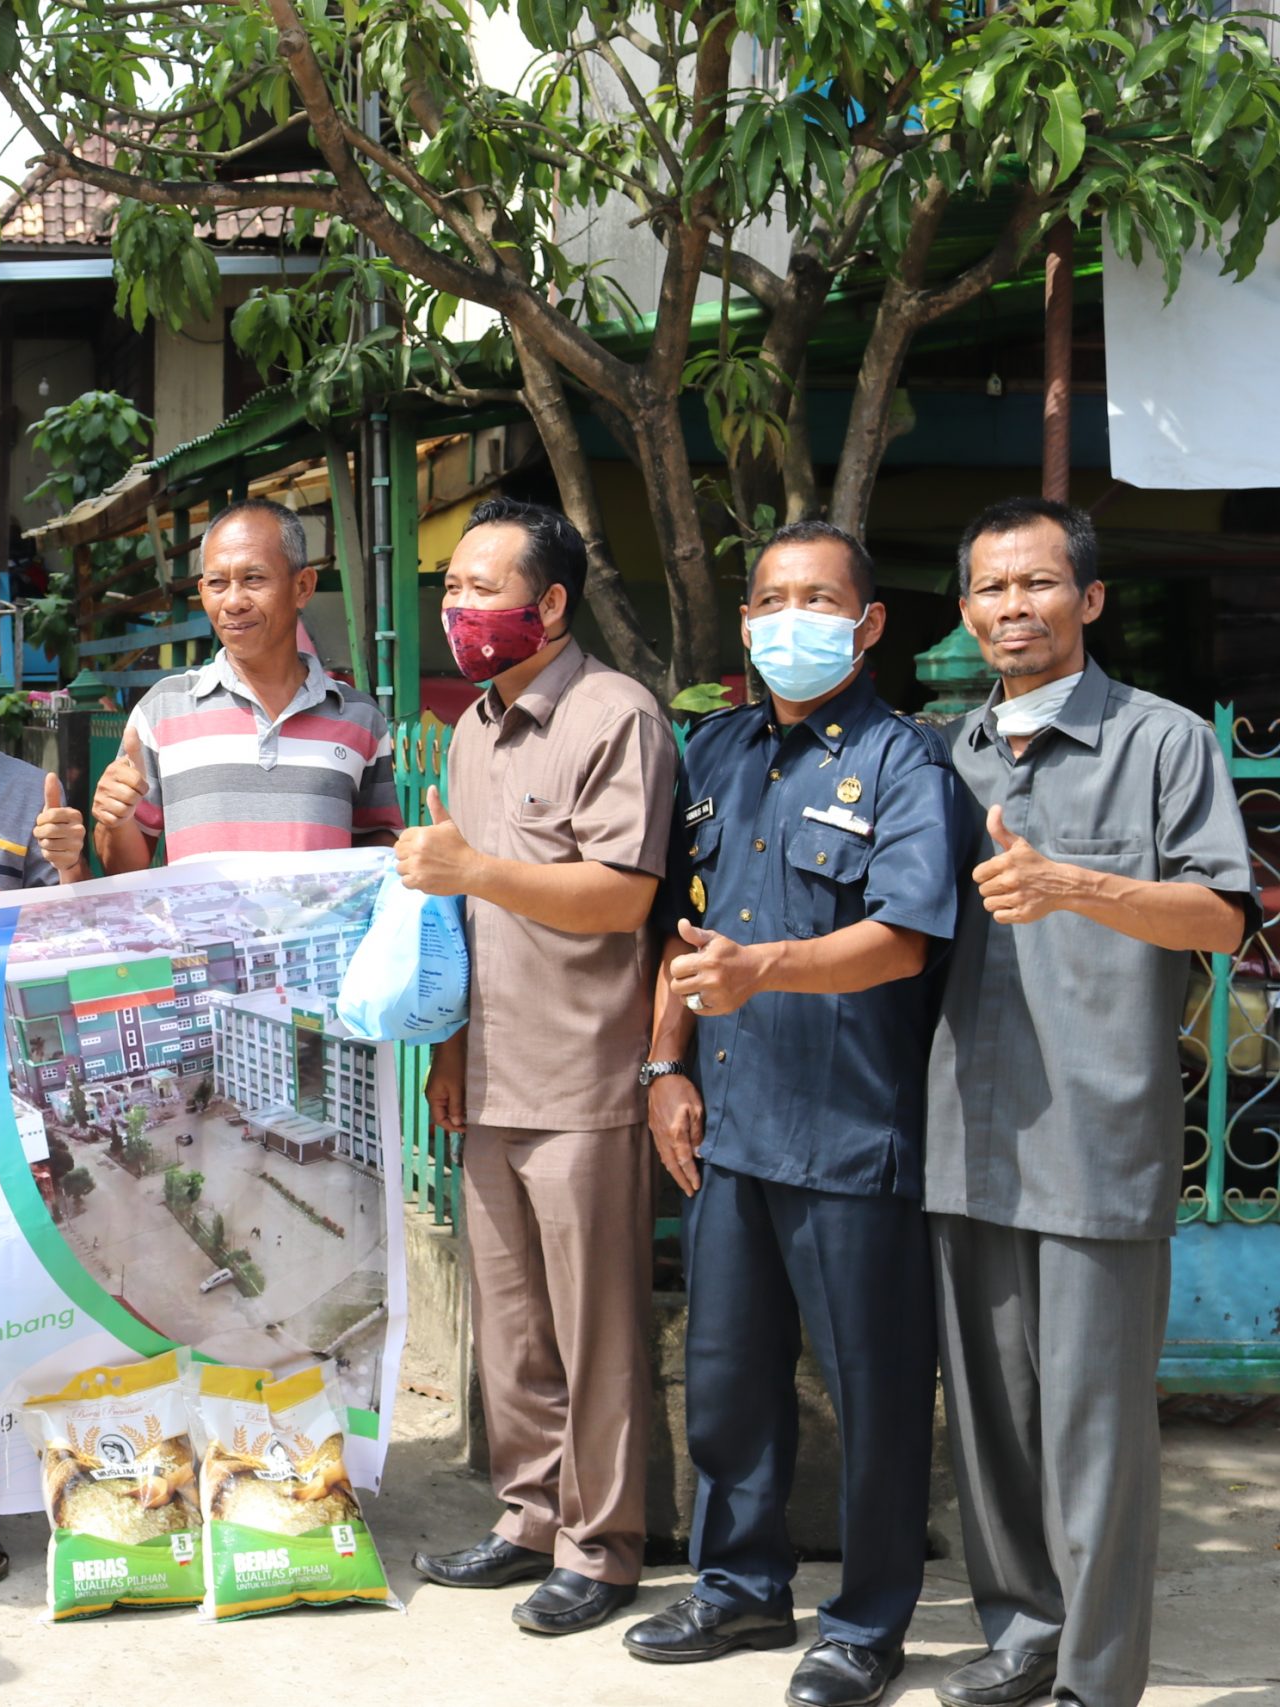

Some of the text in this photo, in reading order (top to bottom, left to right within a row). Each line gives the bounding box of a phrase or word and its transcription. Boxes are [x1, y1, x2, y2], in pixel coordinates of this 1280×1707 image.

[177, 1536, 187, 1551] 5
[339, 1527, 349, 1542] 5
[72, 1557, 128, 1581] BERAS
[233, 1547, 290, 1572] BERAS
[74, 1572, 167, 1591] KUALITAS PILIHAN
[235, 1563, 329, 1583] KUALITAS PILIHAN
